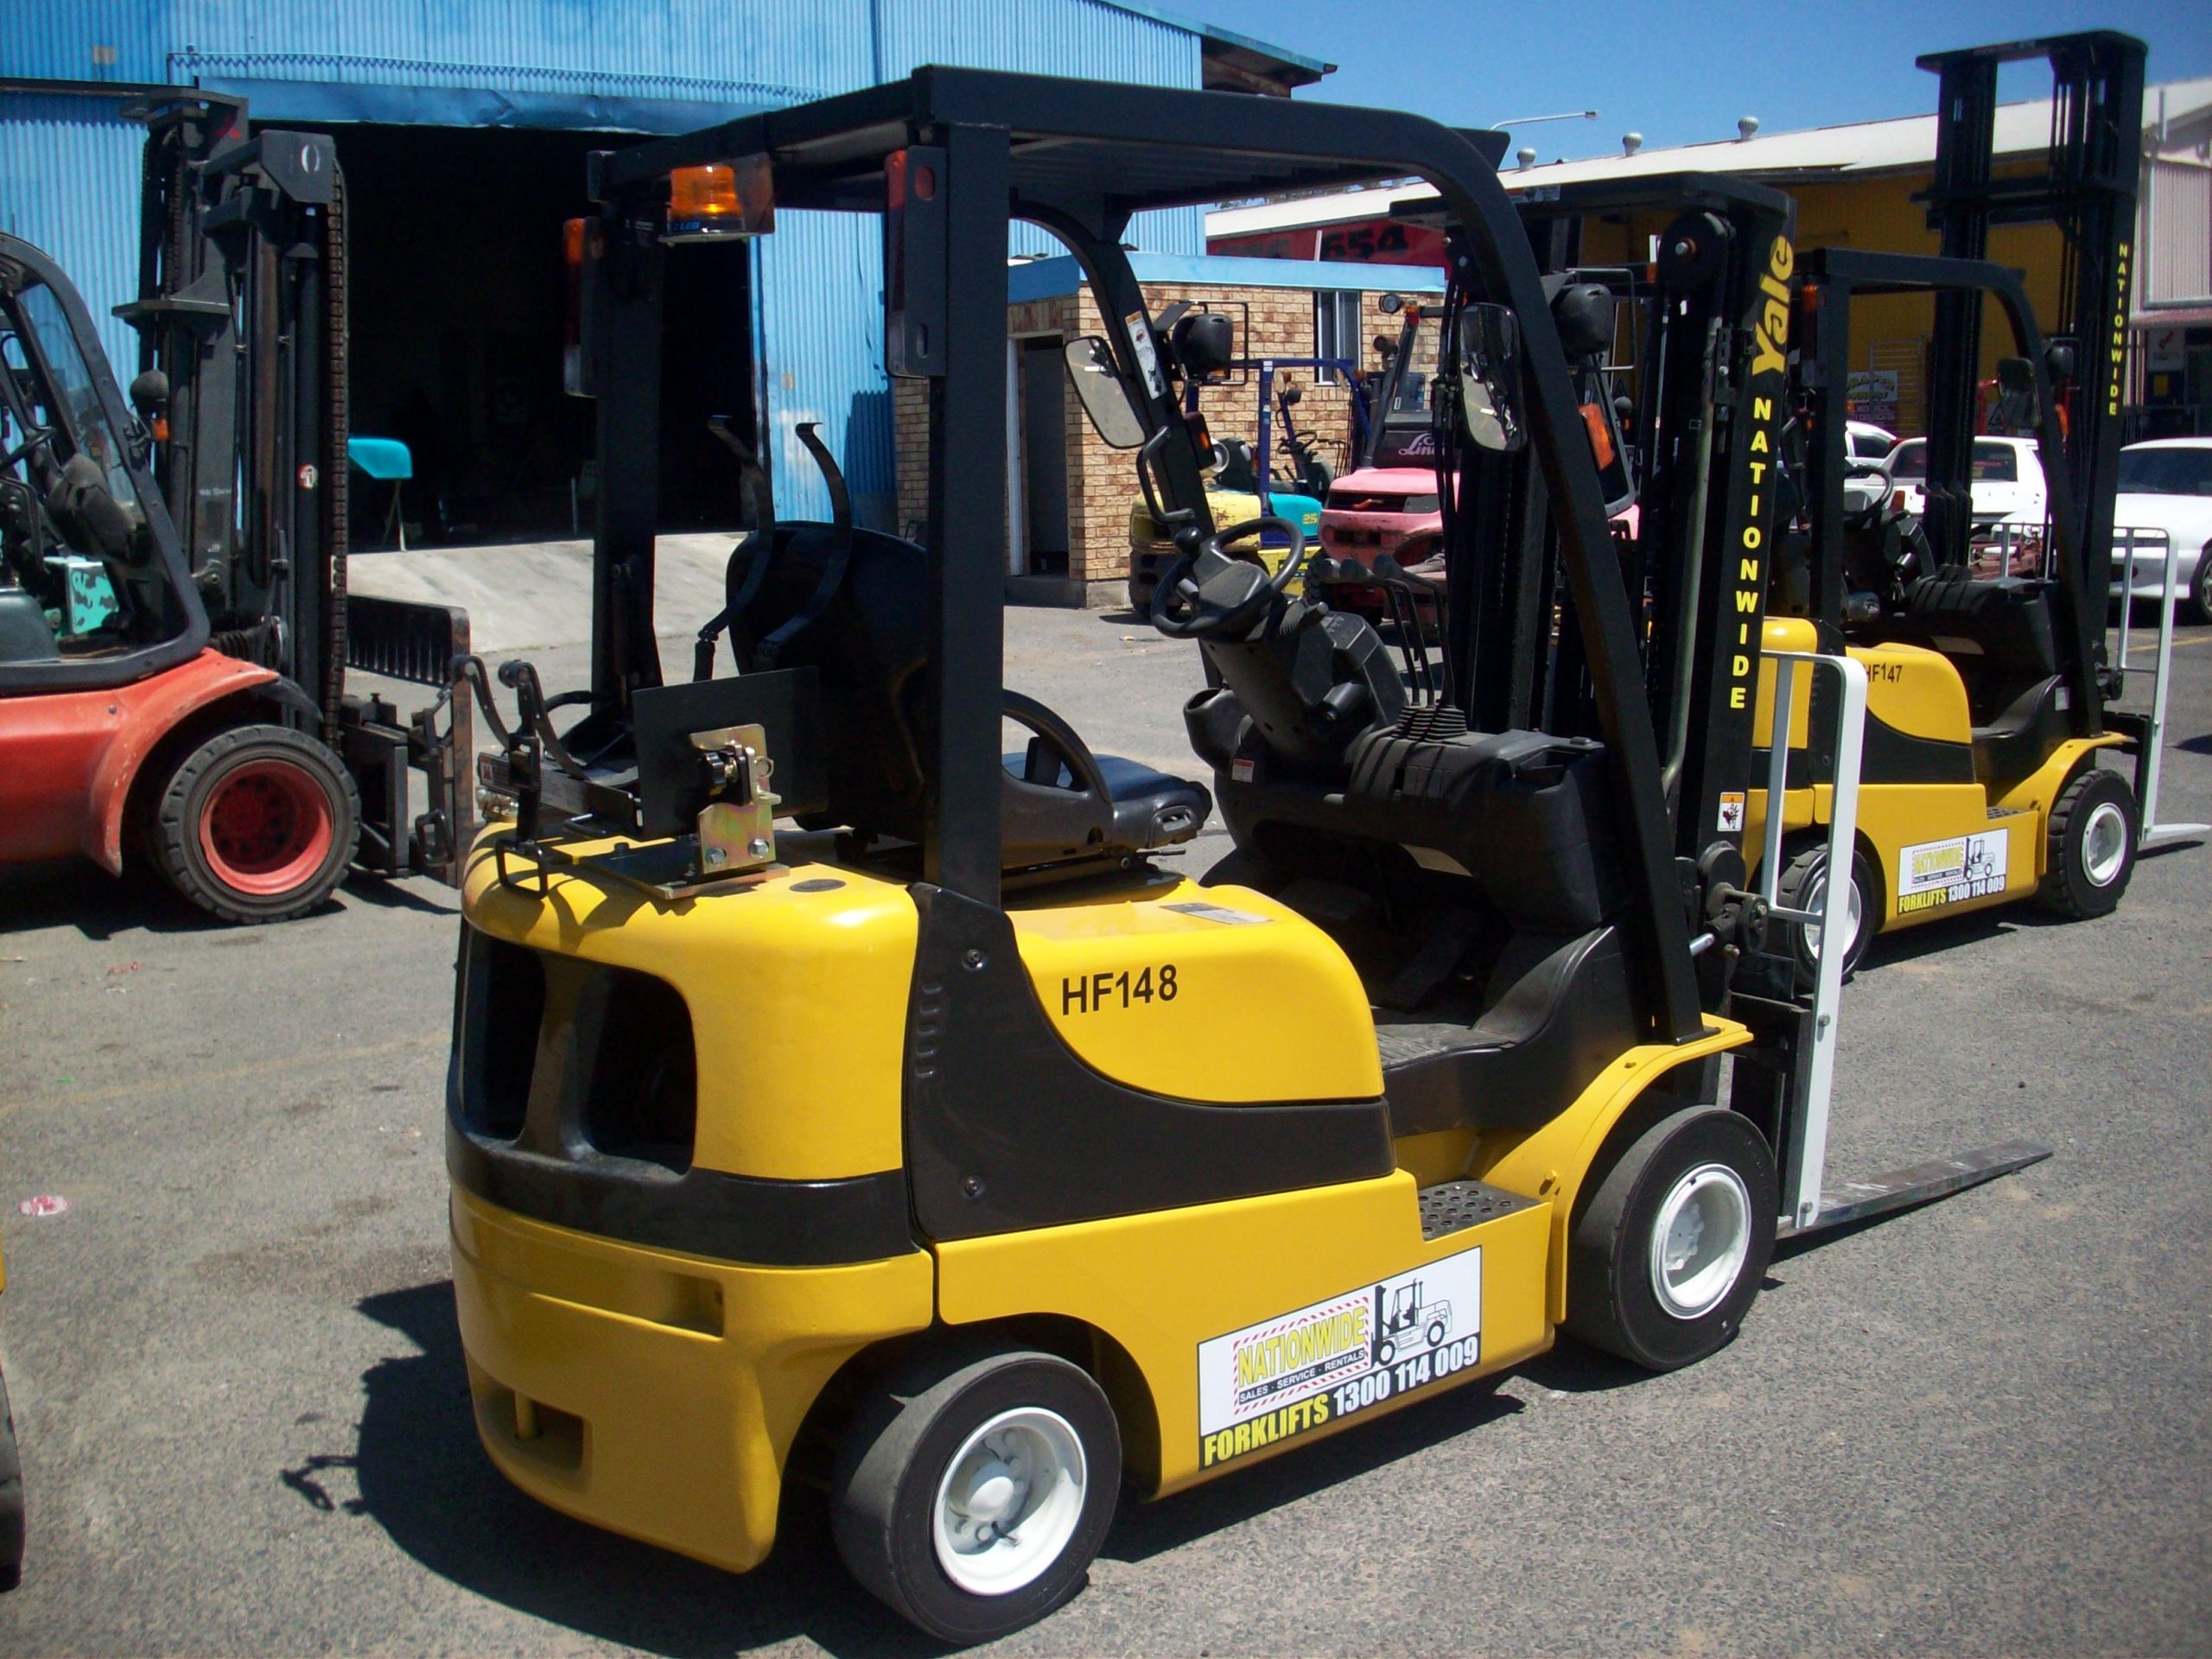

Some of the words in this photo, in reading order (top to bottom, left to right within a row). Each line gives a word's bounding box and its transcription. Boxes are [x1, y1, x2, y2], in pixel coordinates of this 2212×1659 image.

[1751, 234, 1794, 376] Yale
[2108, 242, 2128, 416] NATIONWIDE
[1730, 397, 1771, 709] NATIONWIDE
[1863, 661, 1904, 683] HF147
[1898, 887, 1947, 913] FORKLIFTS
[1948, 883, 1971, 903] 1300
[1971, 879, 1986, 897] 114
[1986, 875, 2005, 893] 009
[1062, 963, 1178, 1016] HF148
[1237, 1306, 1367, 1389] NATIONWIDE
[1239, 1385, 1268, 1404] SALES
[1276, 1367, 1316, 1390] SERVICE
[1324, 1350, 1365, 1372] RENTALS
[1204, 1394, 1329, 1467] FORKLIFTS
[1333, 1370, 1390, 1417] 1300
[1394, 1355, 1431, 1393] 114
[1434, 1335, 1478, 1378] 009
